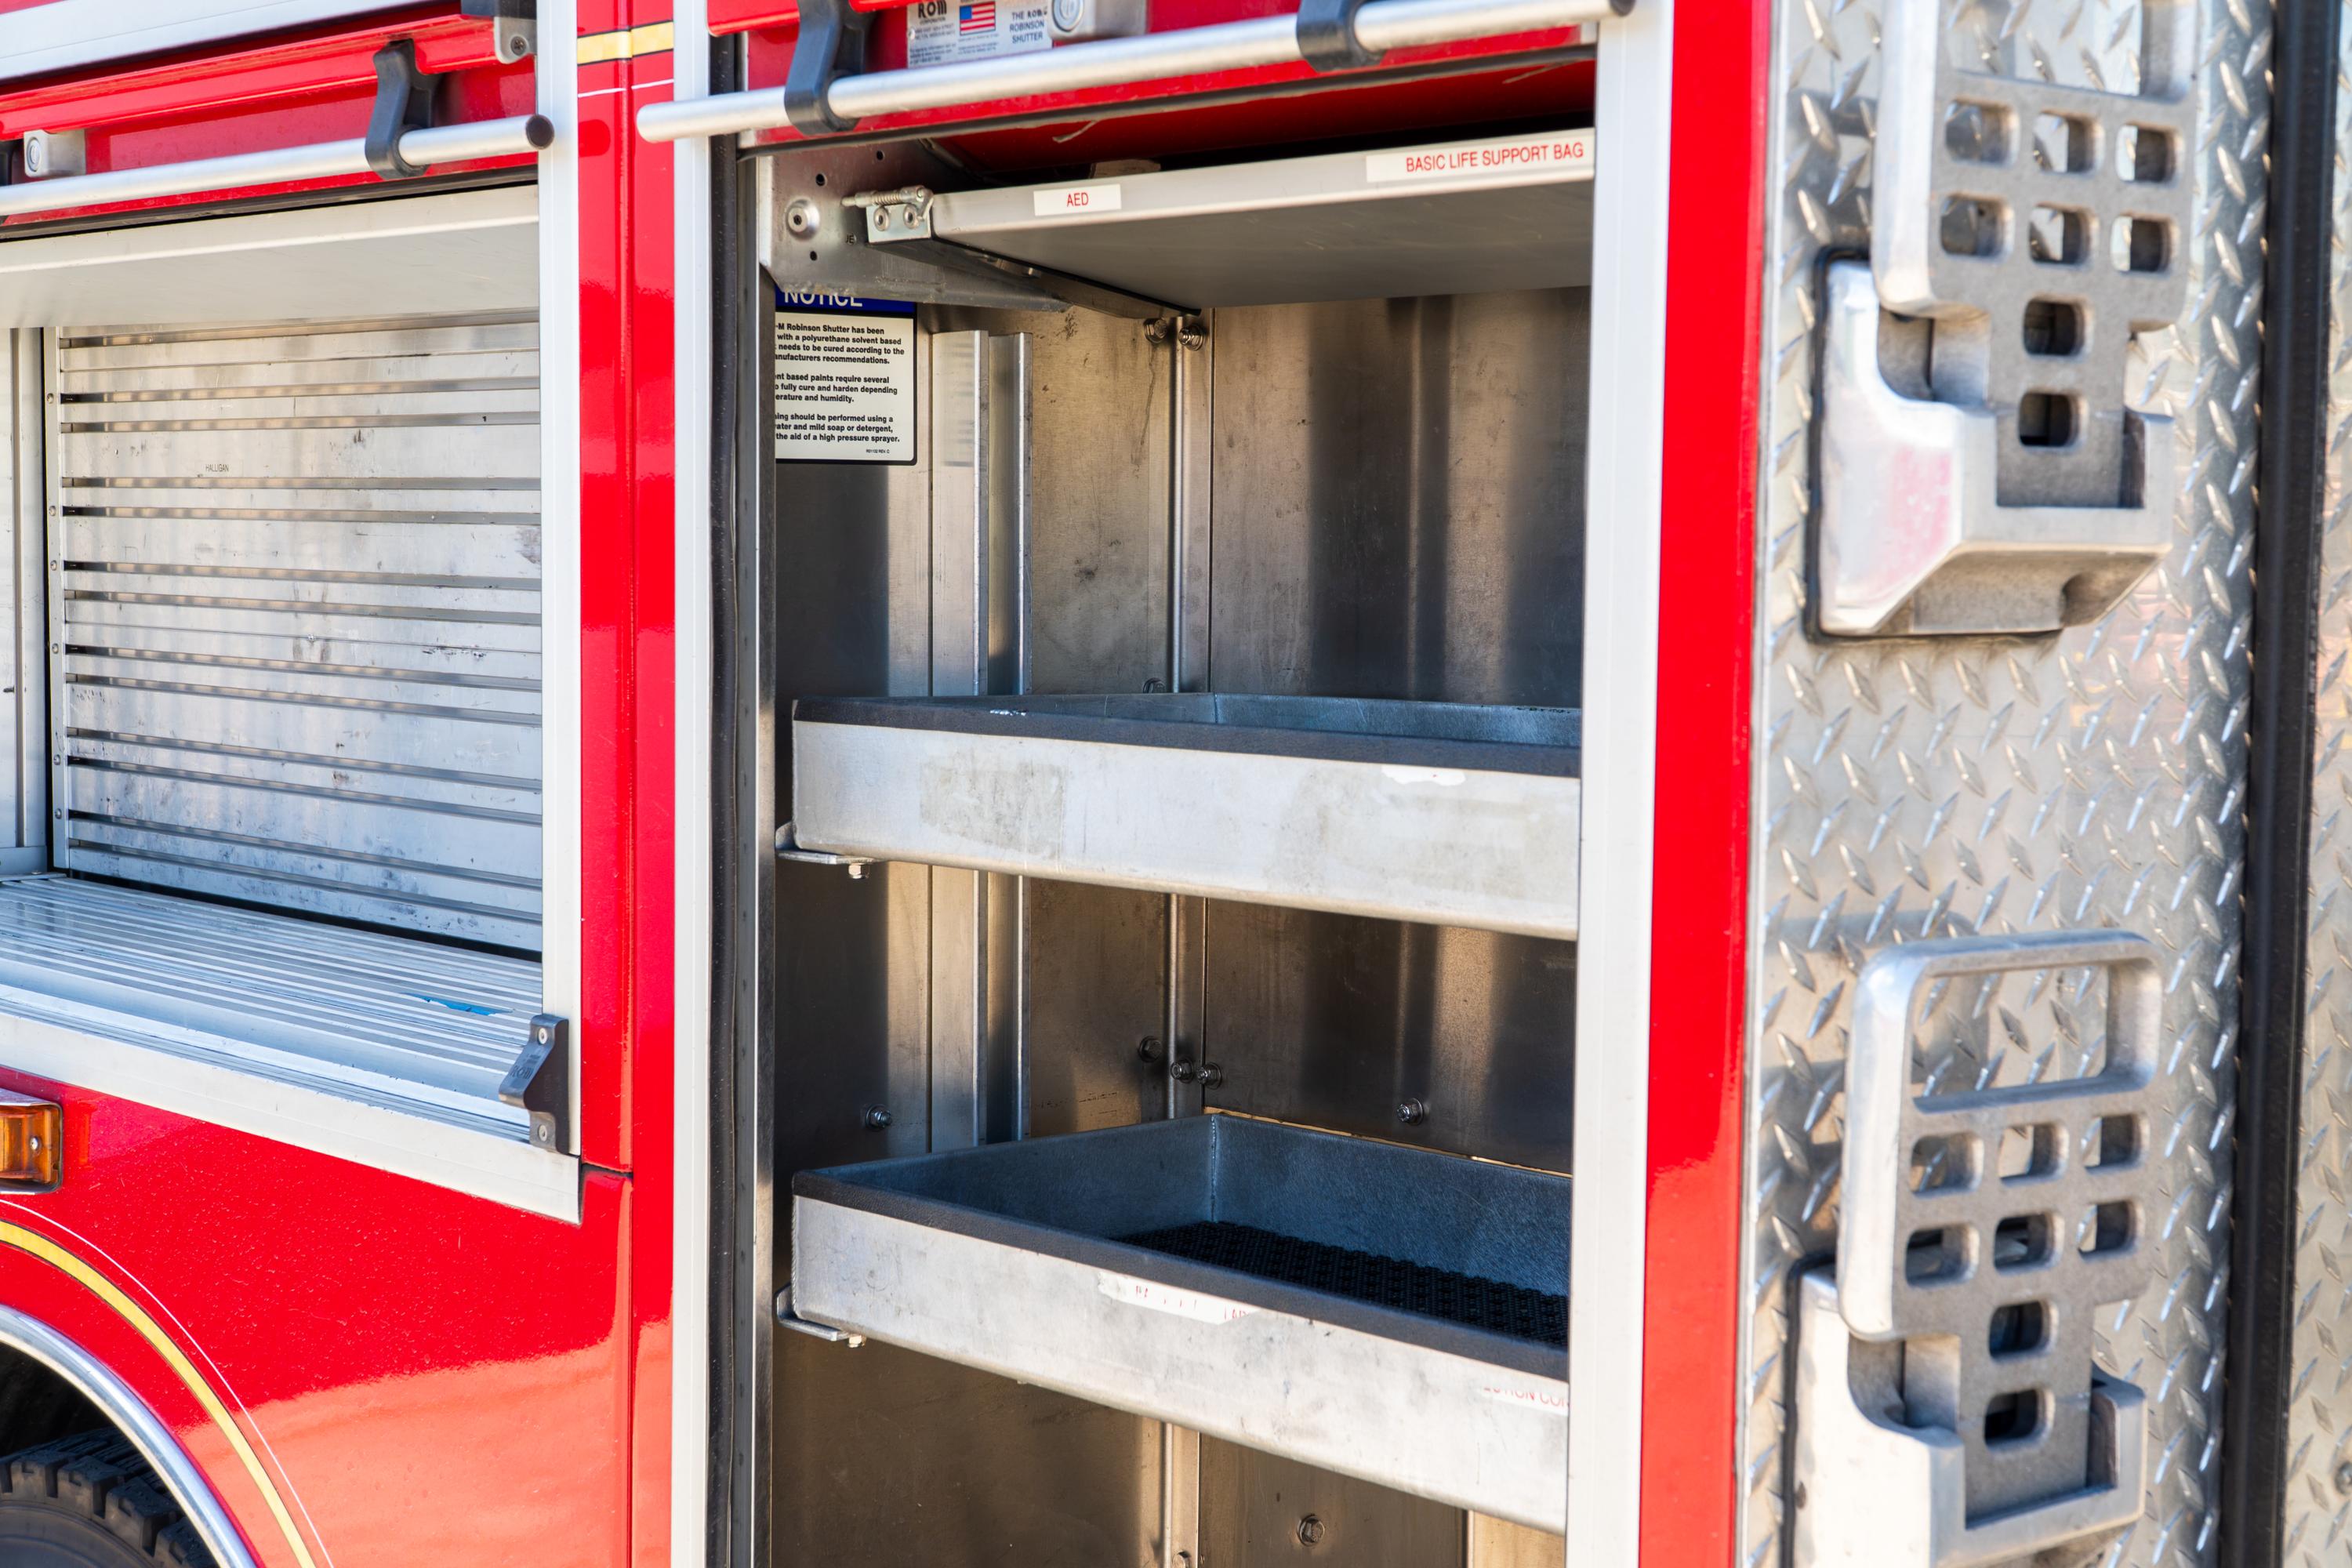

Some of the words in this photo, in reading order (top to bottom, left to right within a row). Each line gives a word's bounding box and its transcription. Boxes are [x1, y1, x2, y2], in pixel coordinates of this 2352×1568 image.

[1012, 11, 1024, 20] THE
[1010, 20, 1044, 32] ROBINSON
[1012, 31, 1043, 43] SHUTTER
[1406, 154, 1446, 172] BASIC
[1449, 151, 1479, 169] LIFE
[1482, 145, 1548, 166] SUPPORT
[1553, 142, 1584, 160] BAG
[1067, 191, 1089, 207] AED
[787, 323, 821, 332] Robinson
[823, 325, 850, 333] Shutter
[851, 325, 865, 334] has
[867, 326, 884, 335] been
[802, 334, 850, 343] polyurethane
[851, 336, 878, 344] solvent
[846, 346, 882, 355] according
[822, 354, 890, 365] recommendations.
[810, 374, 834, 383] paints
[836, 375, 862, 383] require
[781, 383, 797, 392] fully
[833, 384, 858, 393] harden
[860, 385, 898, 395] depending
[820, 394, 855, 404] humidity.
[828, 414, 866, 423] performed
[867, 415, 887, 424] using
[827, 424, 845, 433] soap
[856, 424, 893, 434] detergent,
[819, 433, 836, 442] high
[837, 435, 869, 444] pressure
[871, 435, 900, 445] sprayer.
[205, 463, 230, 472] HALLIGAN
